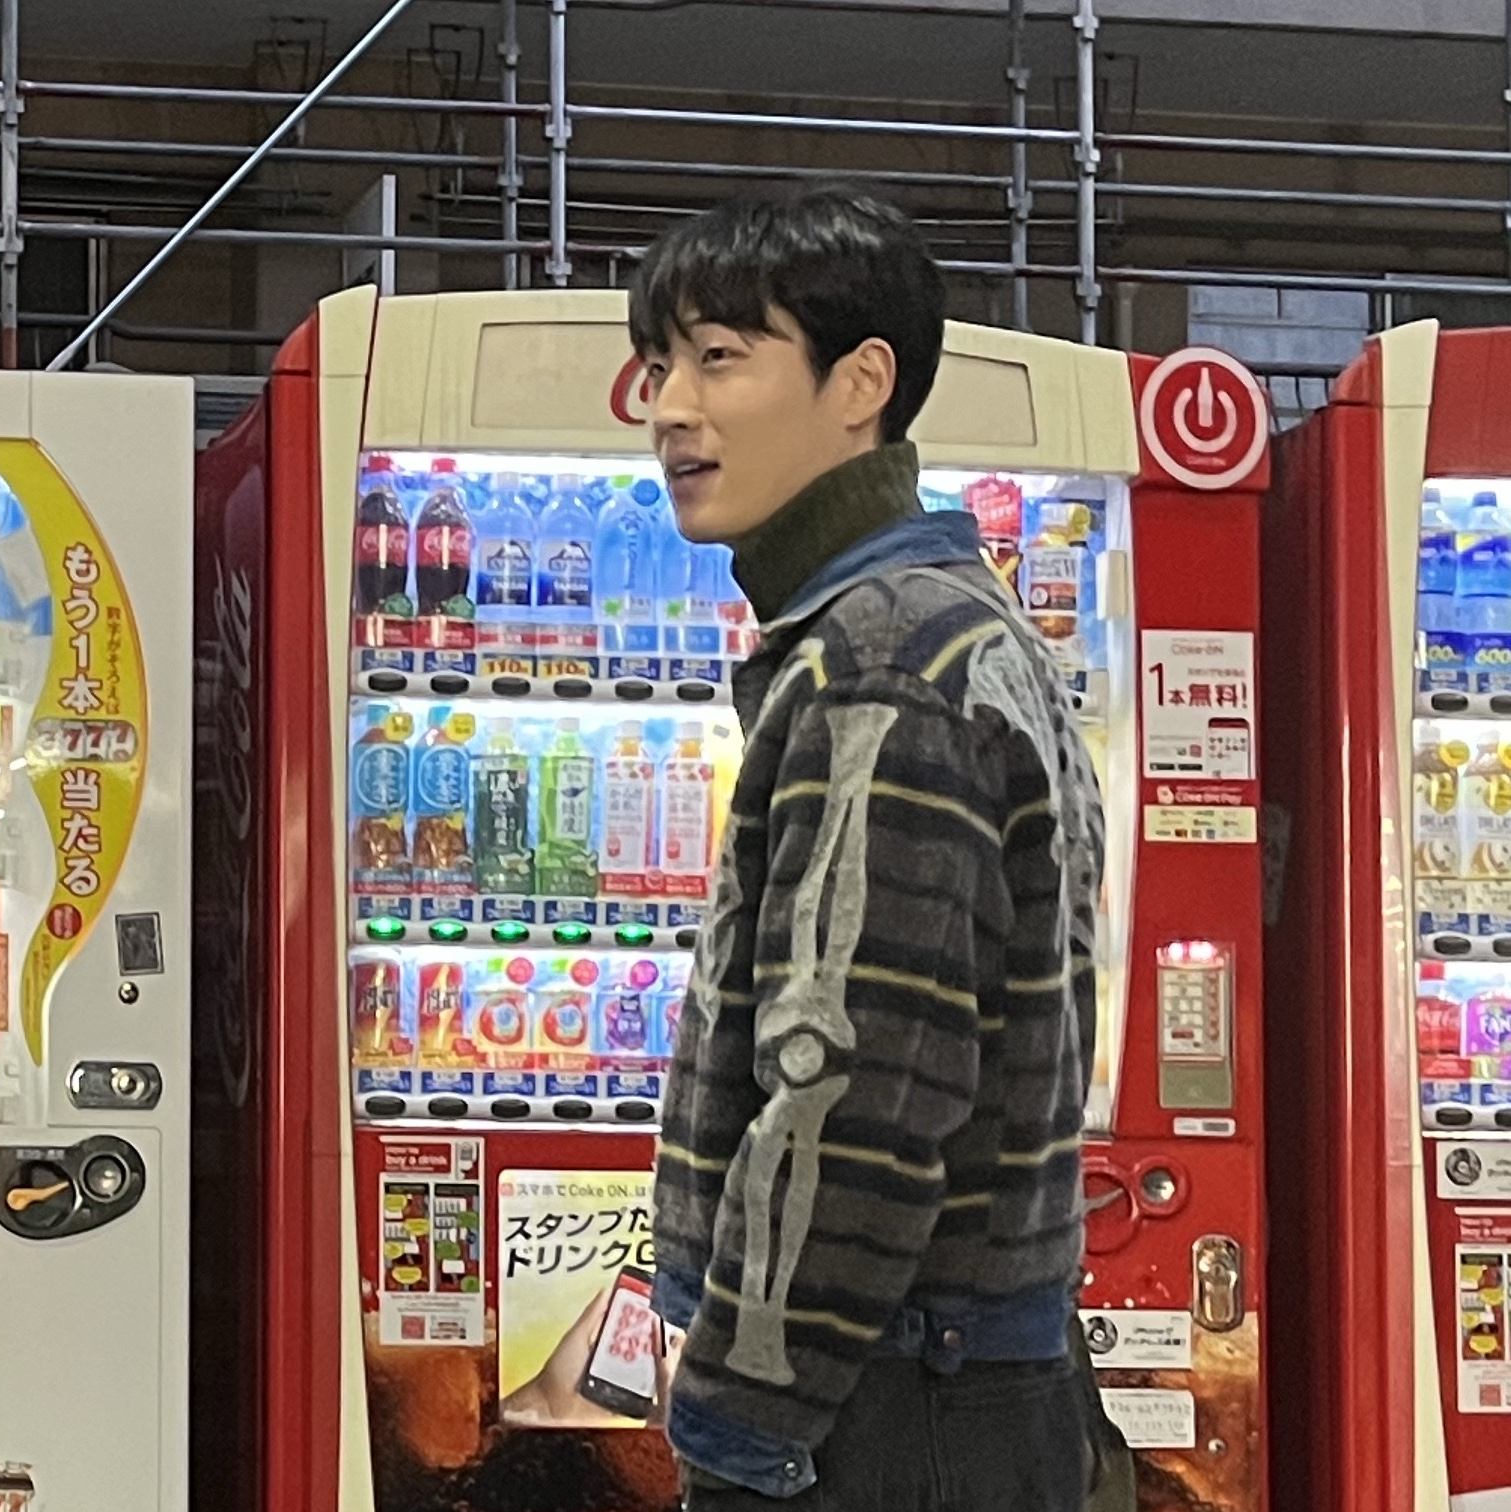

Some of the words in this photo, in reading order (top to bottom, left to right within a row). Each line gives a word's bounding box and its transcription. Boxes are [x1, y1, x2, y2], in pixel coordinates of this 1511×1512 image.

[61, 542, 101, 714] もう1本
[1148, 662, 1248, 709] 1本無料!
[58, 767, 100, 897] 当たる
